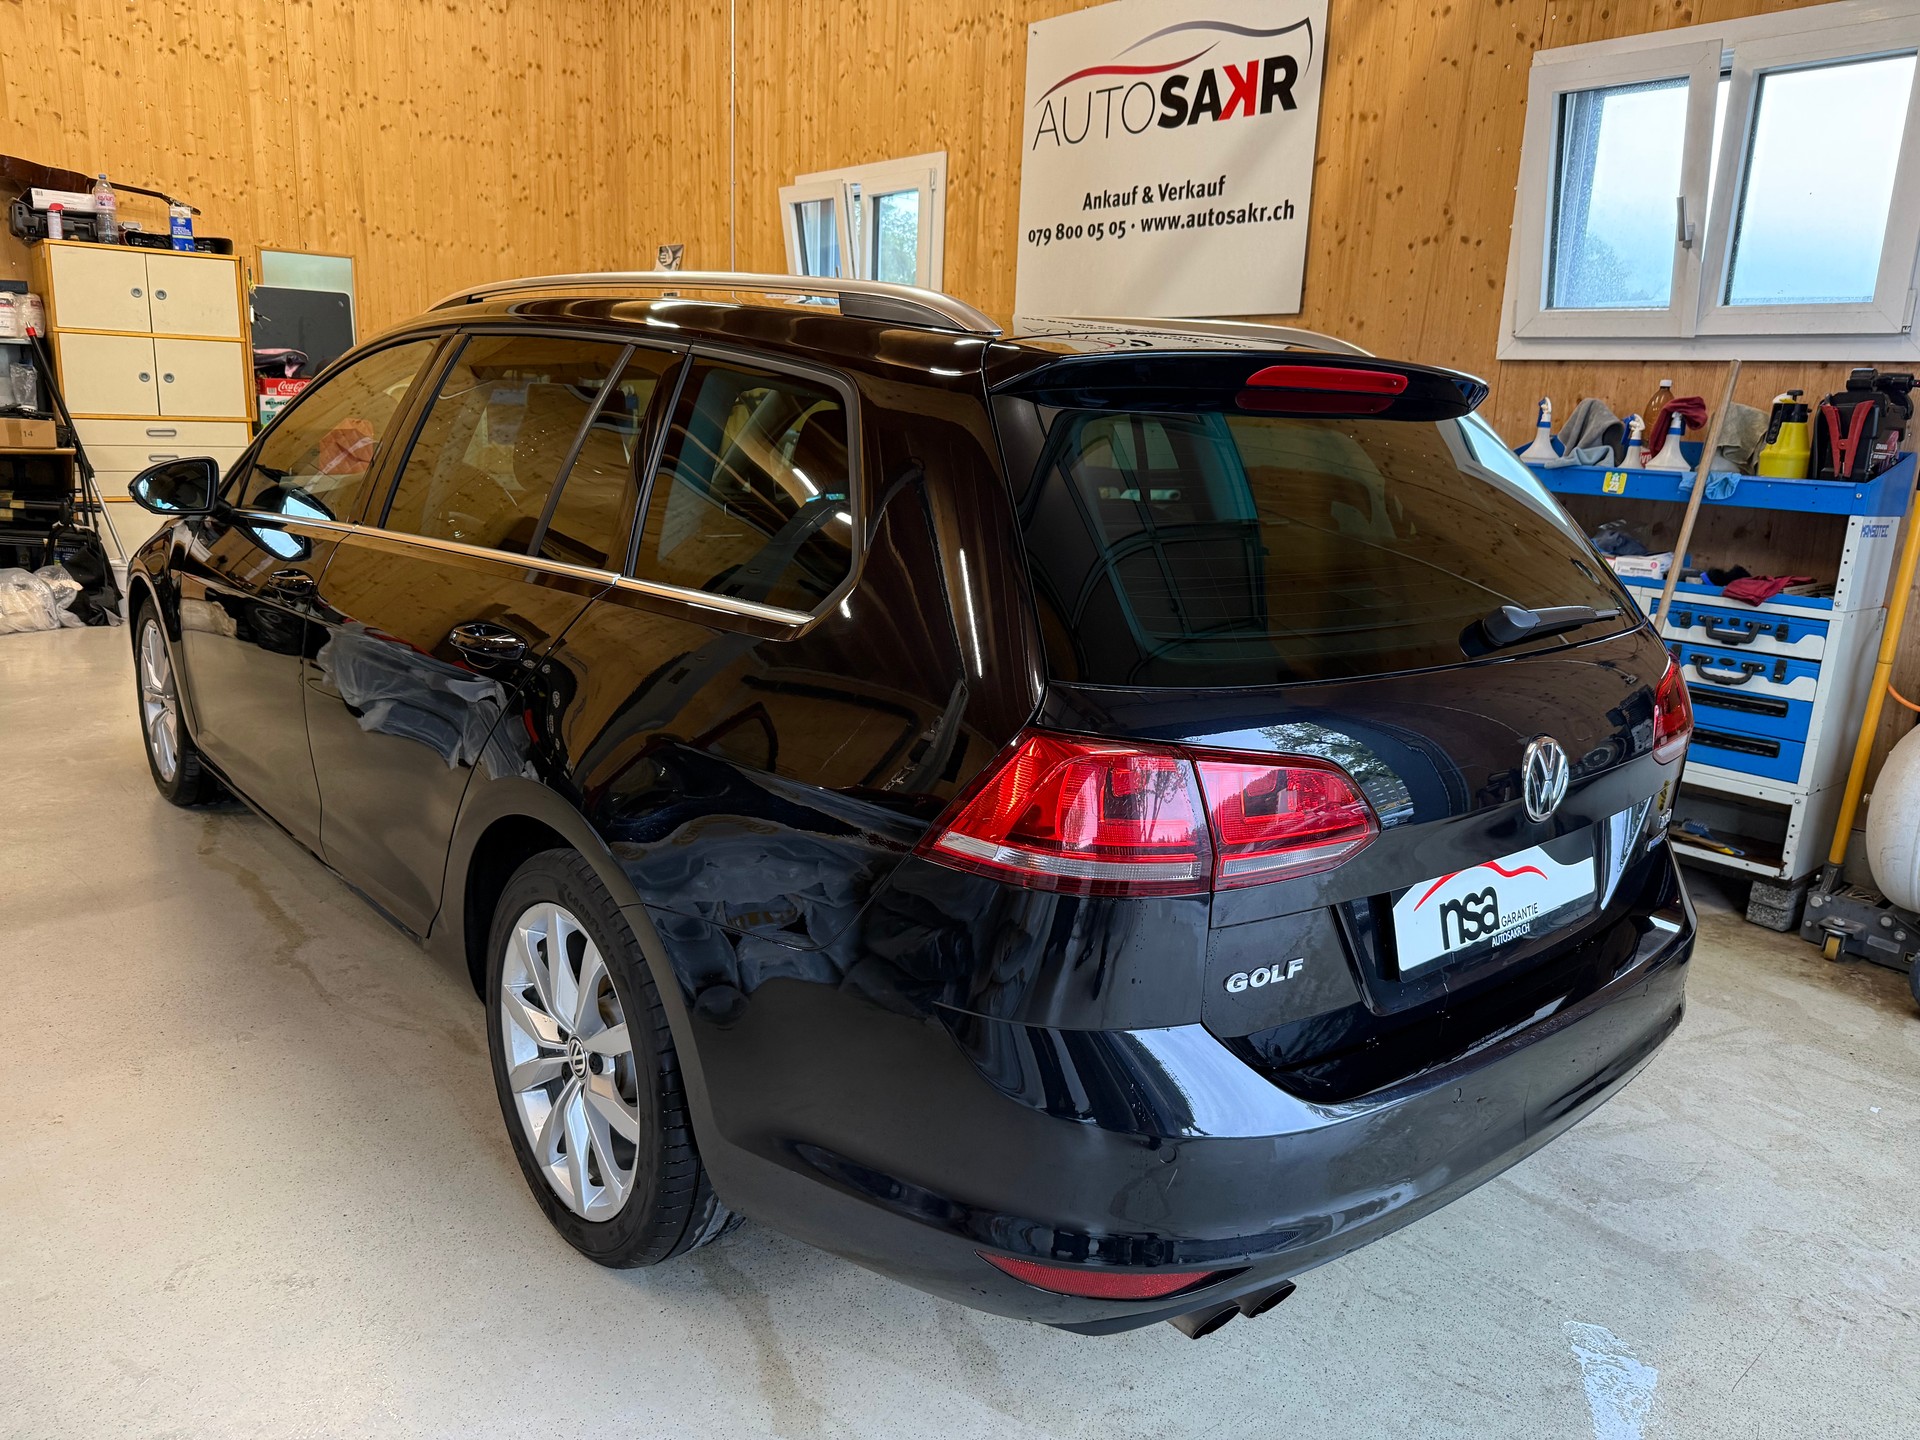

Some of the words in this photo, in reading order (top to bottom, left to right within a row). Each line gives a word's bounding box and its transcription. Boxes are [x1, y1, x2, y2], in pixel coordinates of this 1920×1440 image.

[1032, 55, 1298, 150] AUTOSAKR
[1083, 186, 1138, 211] Ankauf
[1142, 186, 1154, 203] &
[1158, 175, 1226, 201] Verkauf
[1028, 228, 1051, 246] 079
[1055, 223, 1083, 241] 800
[1087, 222, 1104, 241] 05
[1109, 220, 1126, 239] 05
[1140, 199, 1295, 233] www.autosakr.ch
[1439, 886, 1500, 950] nsa
[1501, 902, 1539, 927] GARANTIE
[1223, 957, 1304, 993] GOLF
